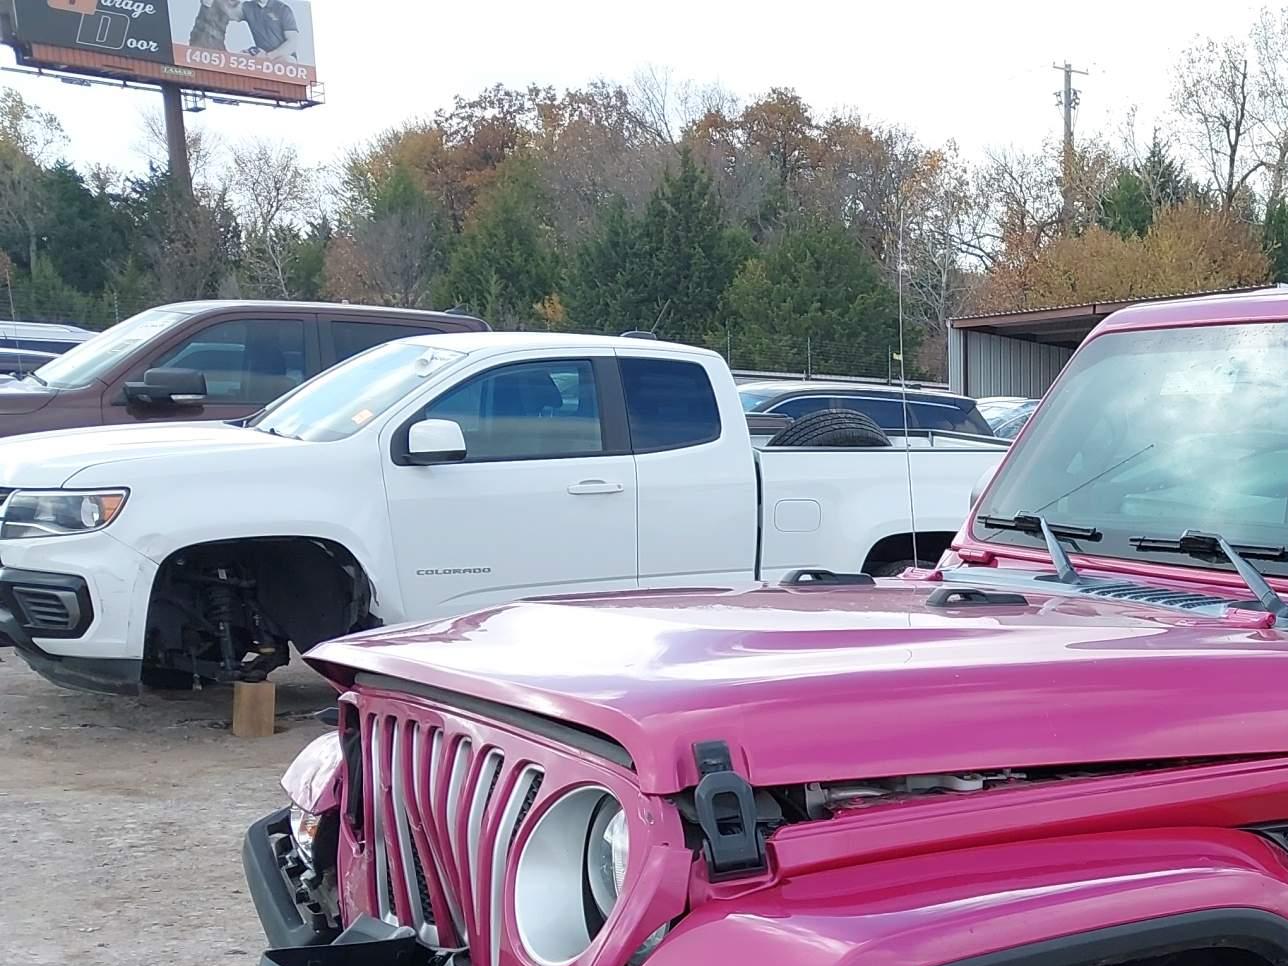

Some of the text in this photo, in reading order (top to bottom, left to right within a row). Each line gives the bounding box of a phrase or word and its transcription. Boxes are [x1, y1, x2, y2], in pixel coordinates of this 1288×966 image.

[185, 48, 308, 80] (405) 525-DOOR
[416, 567, 492, 576] COLORADO
